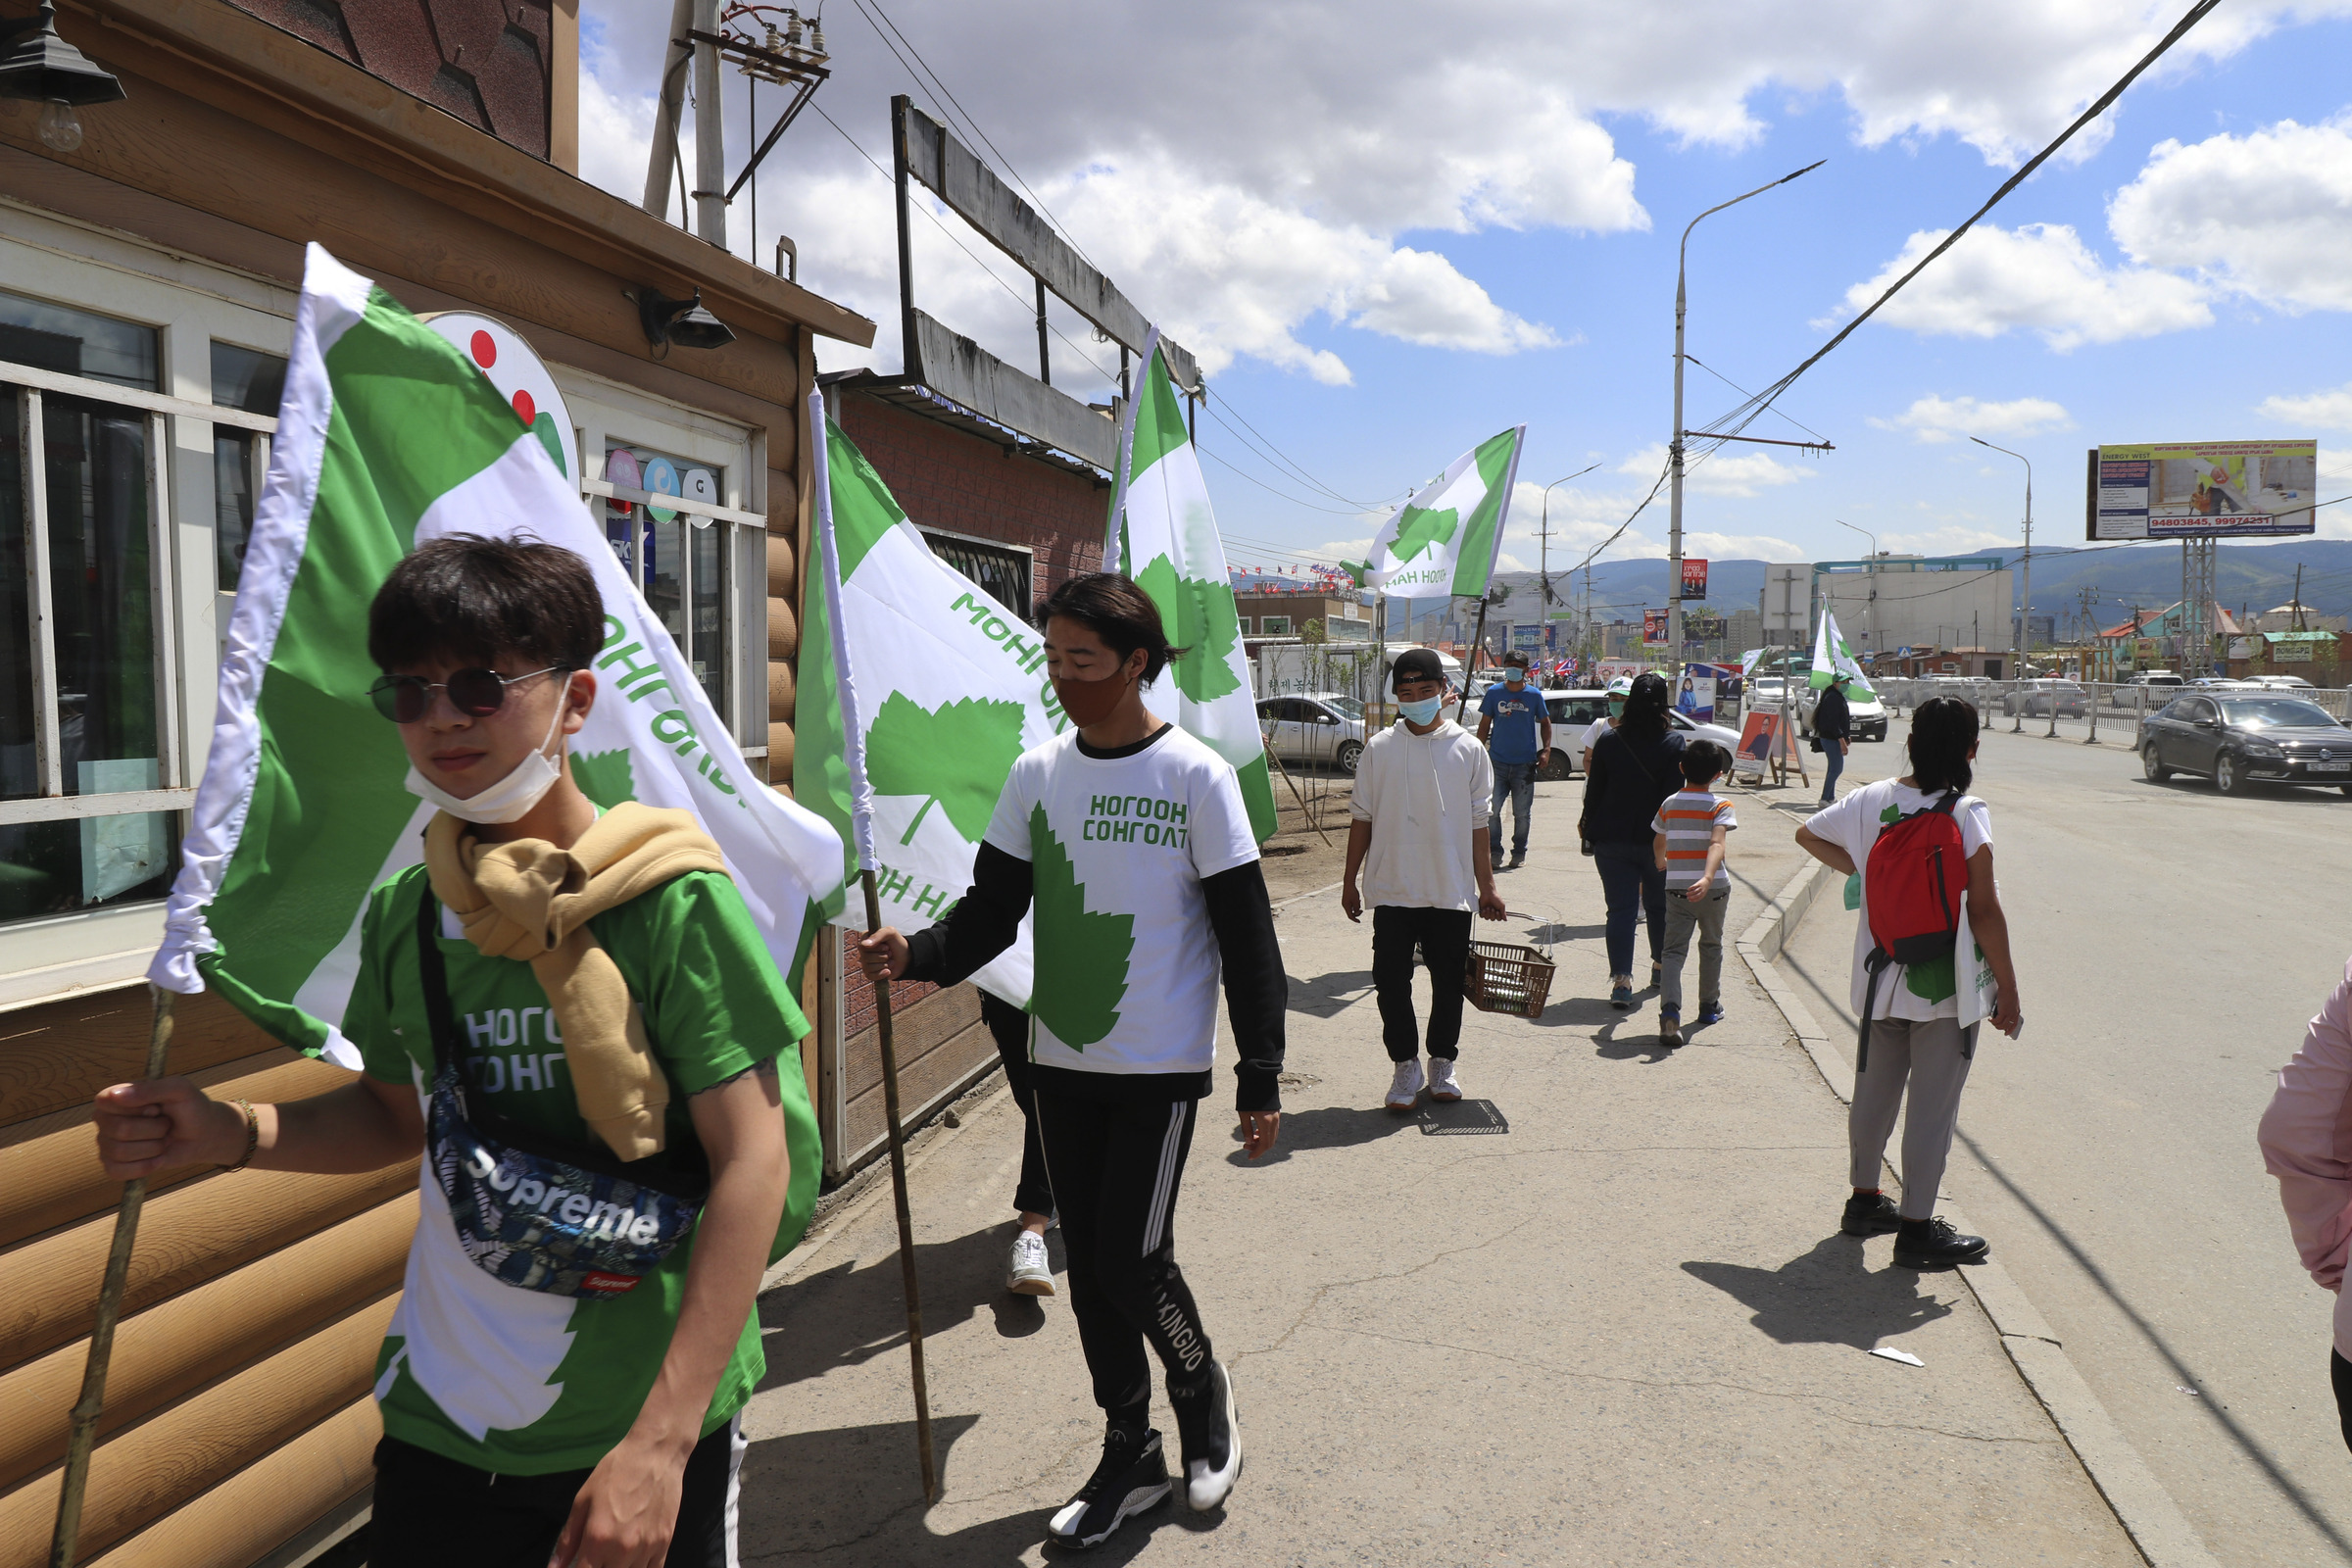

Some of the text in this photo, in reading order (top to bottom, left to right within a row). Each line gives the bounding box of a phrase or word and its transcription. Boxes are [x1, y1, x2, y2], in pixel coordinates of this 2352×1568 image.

[2151, 517, 2212, 527] 94803845,
[1090, 795, 1187, 825] НОГООН
[1083, 819, 1188, 850] СОНГОЛТ
[464, 1006, 564, 1049] НОГО
[465, 1144, 661, 1246] Supreme
[590, 1276, 637, 1290] Supreme
